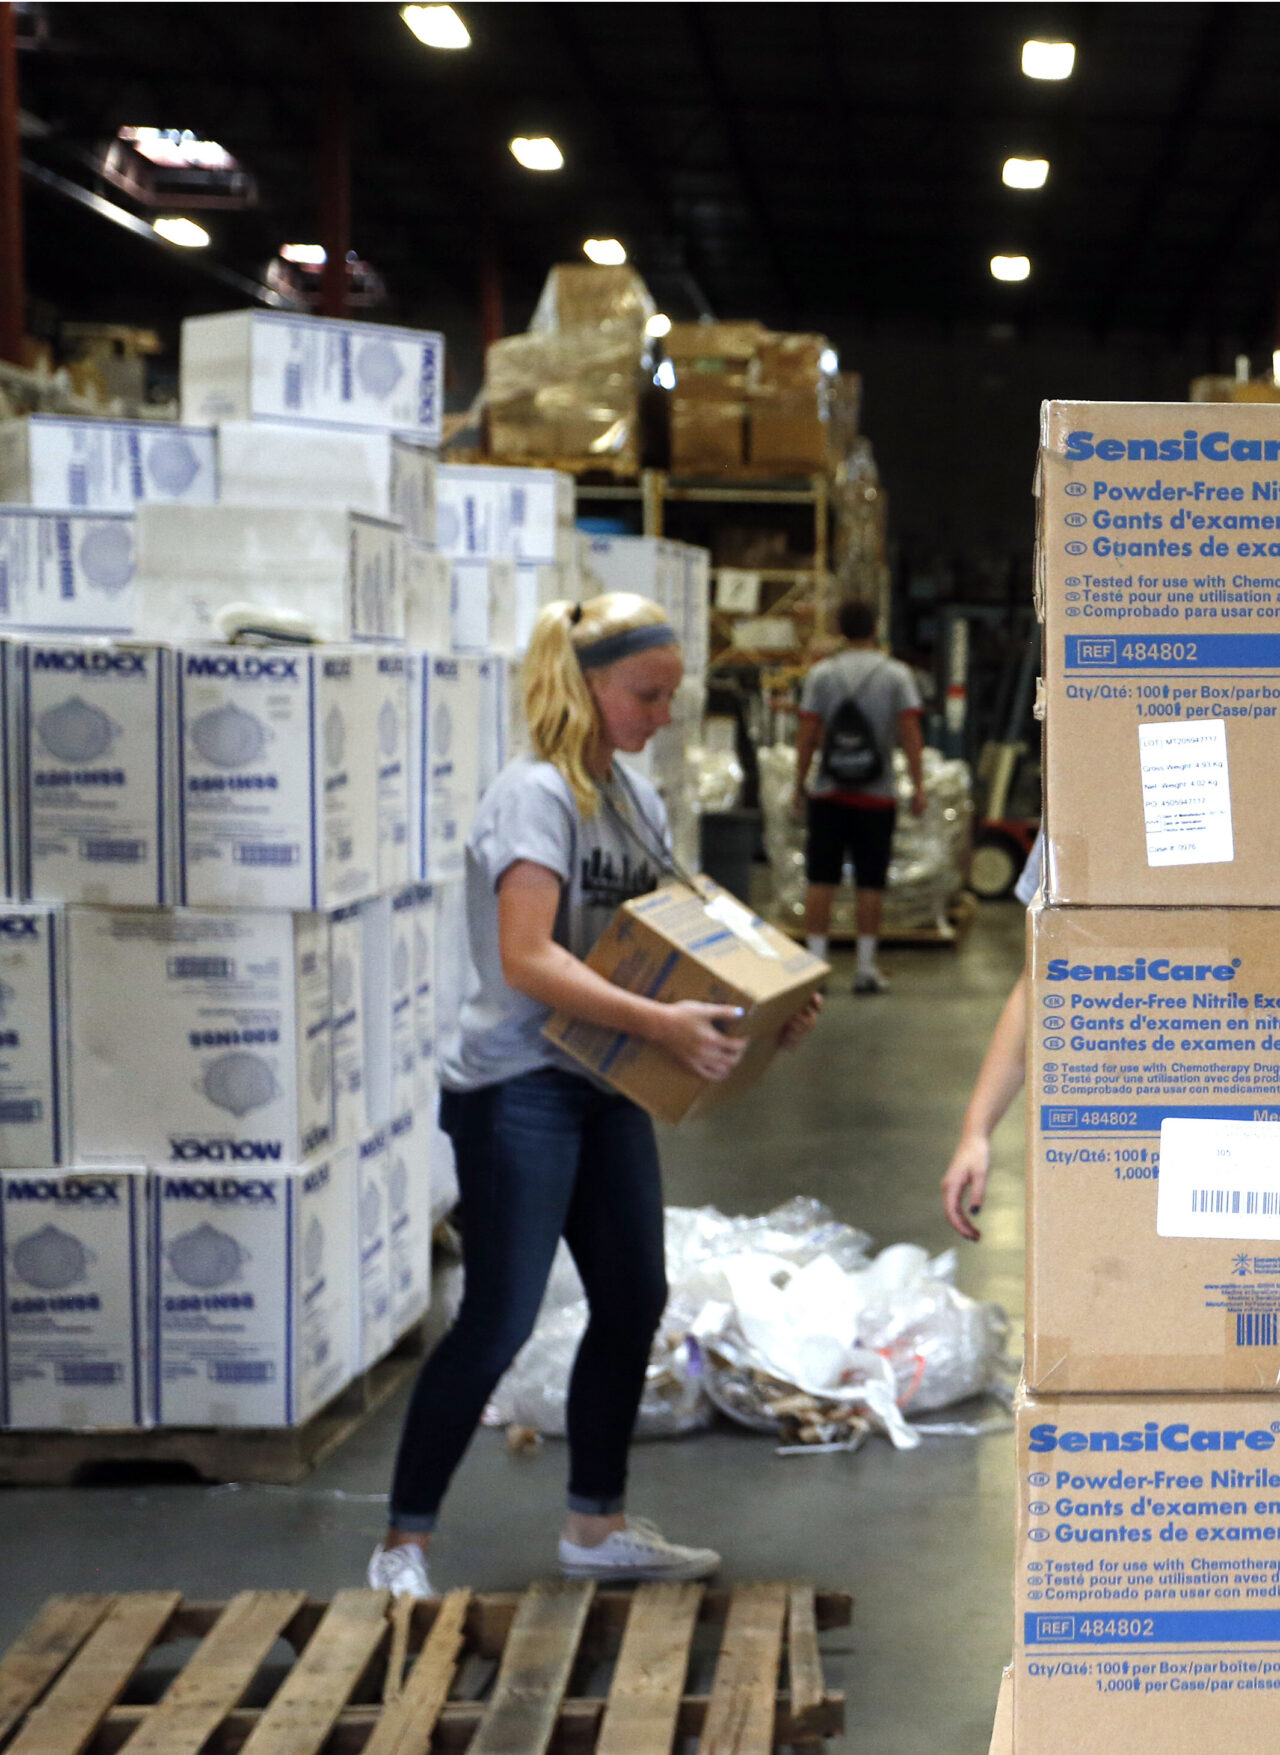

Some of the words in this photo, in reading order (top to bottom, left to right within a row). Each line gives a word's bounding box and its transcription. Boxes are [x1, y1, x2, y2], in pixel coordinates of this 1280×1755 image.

[1094, 480, 1245, 501] Powder-Free
[1093, 510, 1163, 530] Gants
[1093, 536, 1192, 557] Guantes
[1200, 536, 1230, 557] de
[1084, 575, 1133, 590] Tested
[1138, 576, 1159, 587] for
[1163, 578, 1189, 588] use
[1194, 576, 1226, 588] with
[1083, 590, 1123, 605] Testé
[1129, 592, 1162, 604] pour
[1168, 593, 1194, 602] une
[1200, 590, 1272, 602] utilisation
[1083, 606, 1179, 619] Comprobado
[1185, 608, 1218, 619] para
[1221, 608, 1253, 617] usar
[1082, 644, 1113, 658] REF
[1123, 643, 1197, 660] 484802
[34, 652, 146, 675] MOLDEX
[187, 657, 298, 679] MOLDEX
[1066, 685, 1133, 700] Qty/Qté:
[1173, 689, 1197, 700] per
[1071, 993, 1187, 1009] Powder-Free
[1193, 993, 1249, 1008] Nitrile
[1052, 1113, 1073, 1123] REF
[1081, 1112, 1136, 1124] 484802
[170, 1139, 281, 1161] MOLDEX
[6, 1180, 118, 1201] MOLDEX
[165, 1181, 275, 1202] MOLDEX
[1056, 1469, 1204, 1490] Powder-Free
[1042, 1621, 1070, 1634] REF
[1081, 1619, 1153, 1636] 484802
